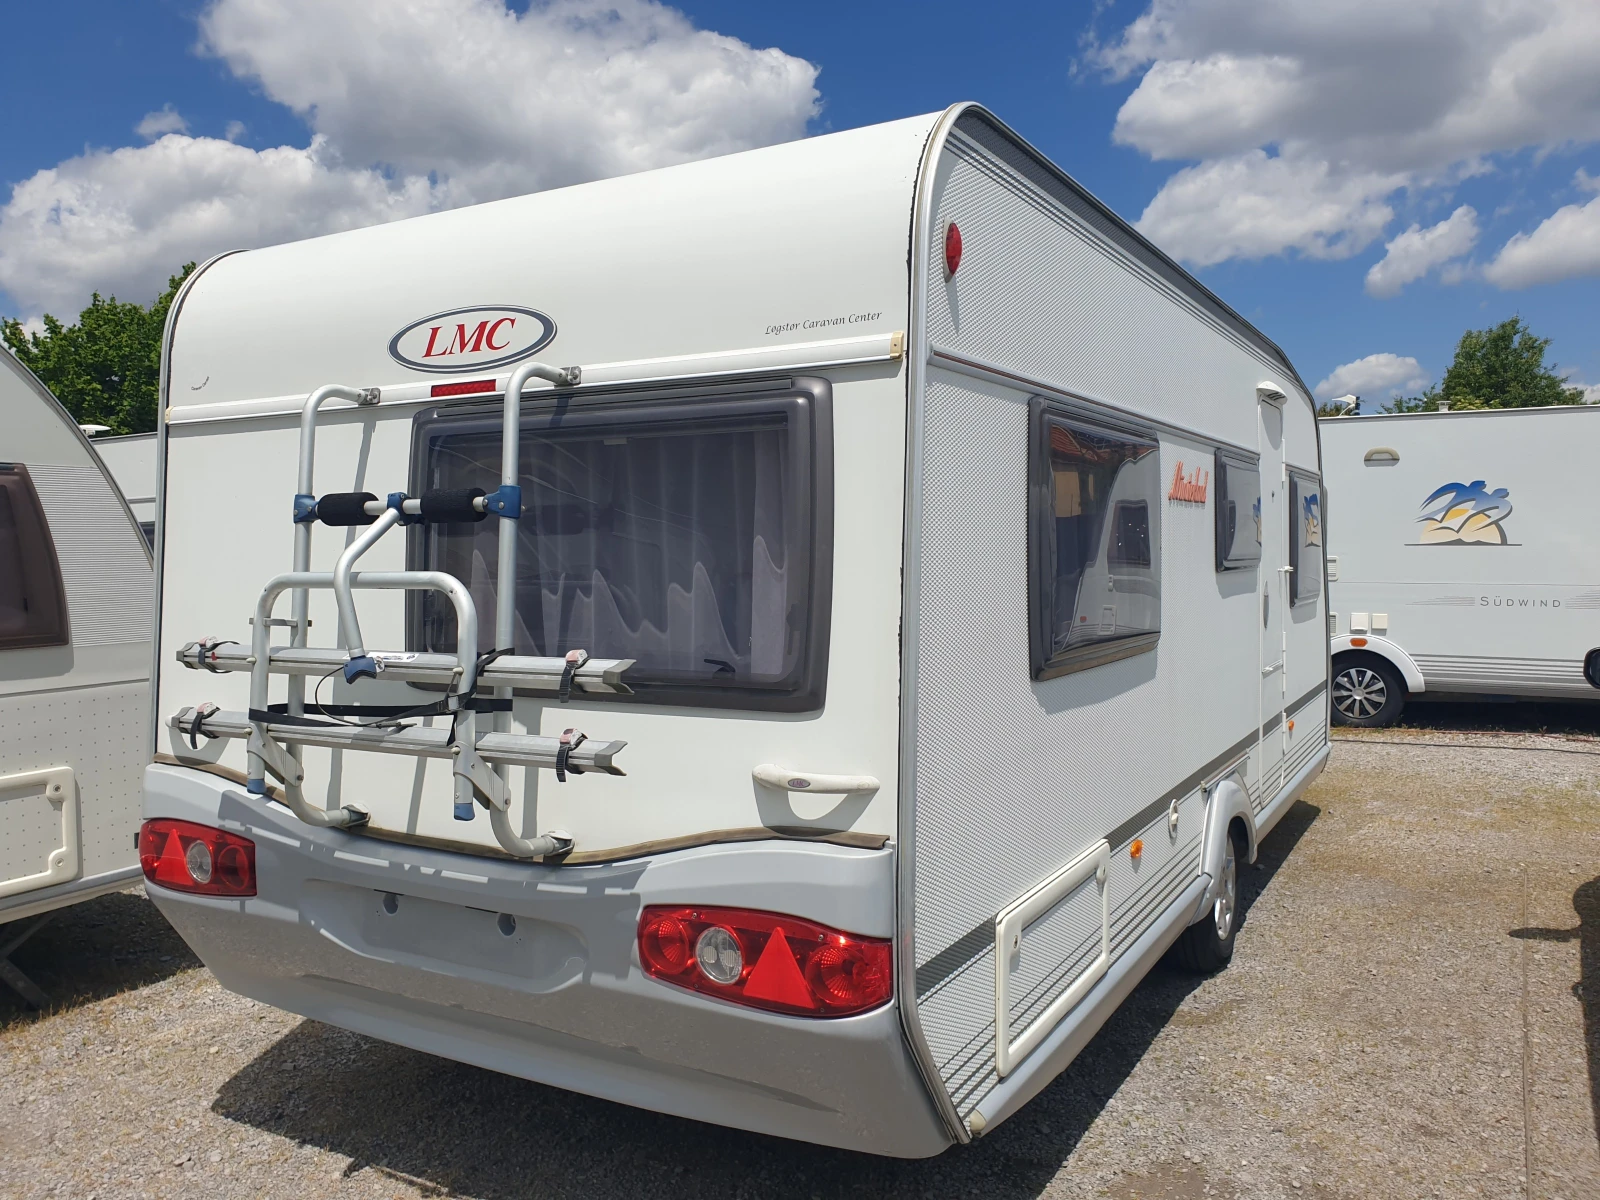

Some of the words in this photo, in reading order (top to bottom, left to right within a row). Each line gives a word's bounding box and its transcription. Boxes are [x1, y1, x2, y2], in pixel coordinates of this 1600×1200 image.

[803, 317, 845, 329] Caravan
[848, 311, 883, 324] Center
[421, 317, 517, 358] LMC
[1480, 595, 1561, 608] SÜDWIND
